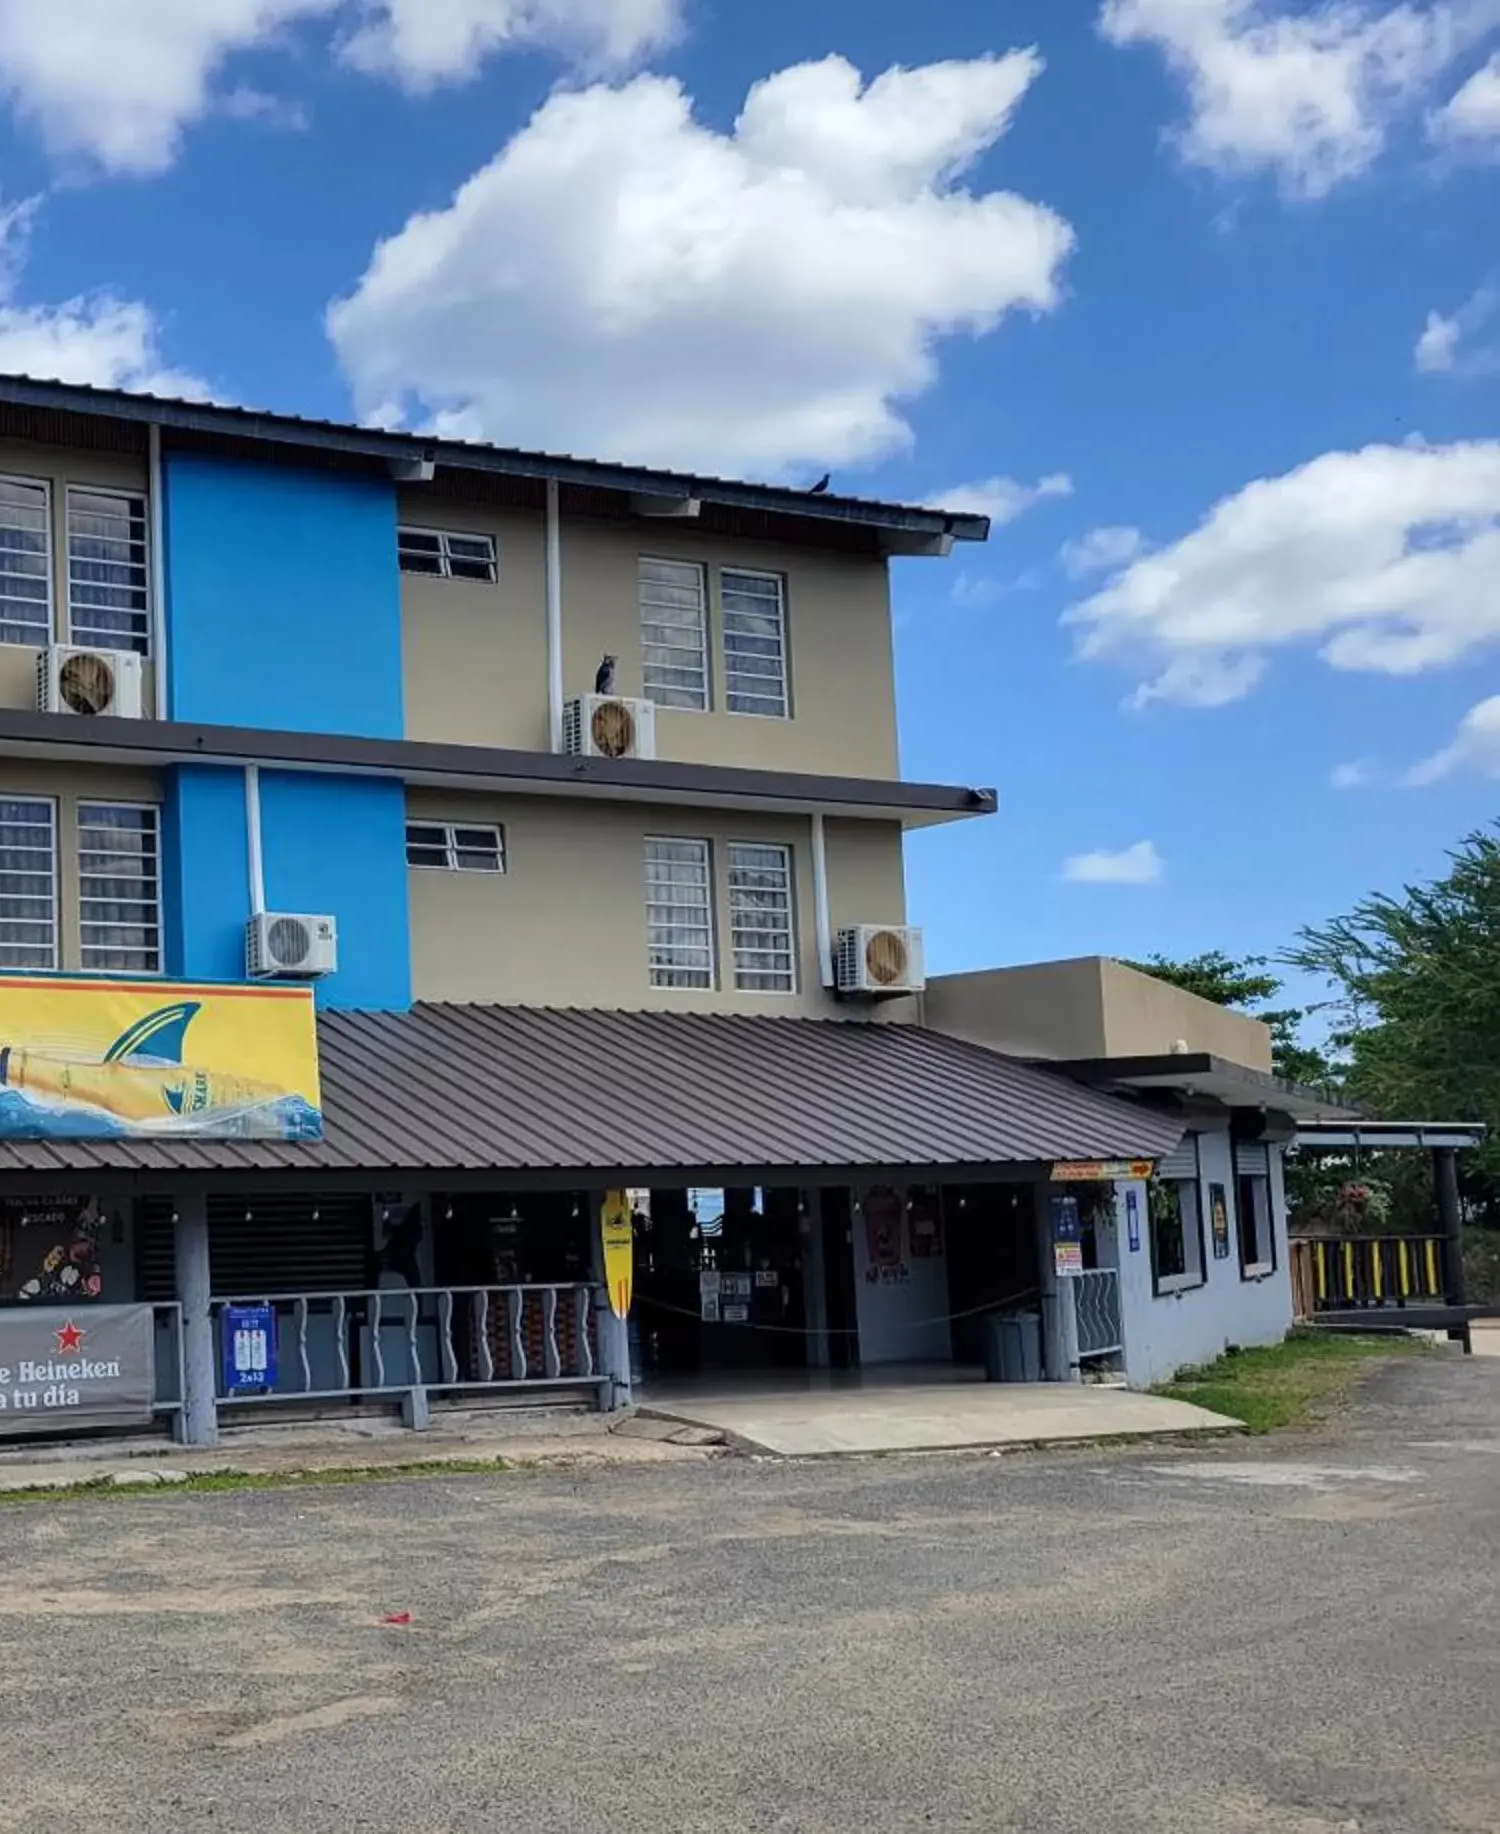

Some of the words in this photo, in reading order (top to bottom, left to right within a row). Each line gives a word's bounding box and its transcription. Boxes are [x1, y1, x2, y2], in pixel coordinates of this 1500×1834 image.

[18, 1359, 120, 1383] Heineken
[13, 1390, 37, 1408] tu
[43, 1383, 80, 1407] día
